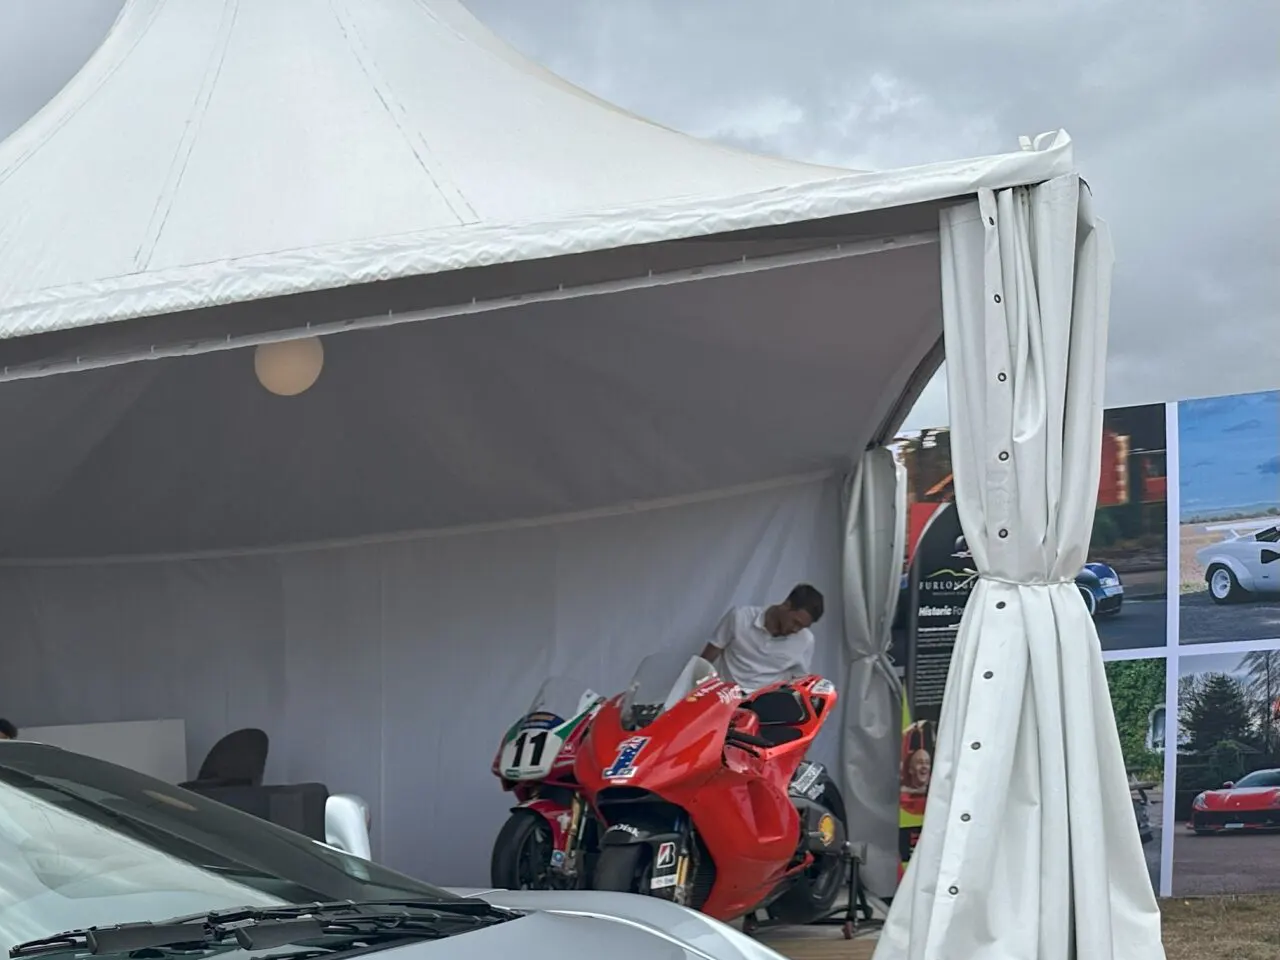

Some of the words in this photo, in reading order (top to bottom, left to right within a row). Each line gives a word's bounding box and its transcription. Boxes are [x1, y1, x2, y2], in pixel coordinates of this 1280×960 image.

[919, 580, 975, 590] FURLONGE
[918, 605, 952, 616] Historic
[513, 731, 550, 768] 11
